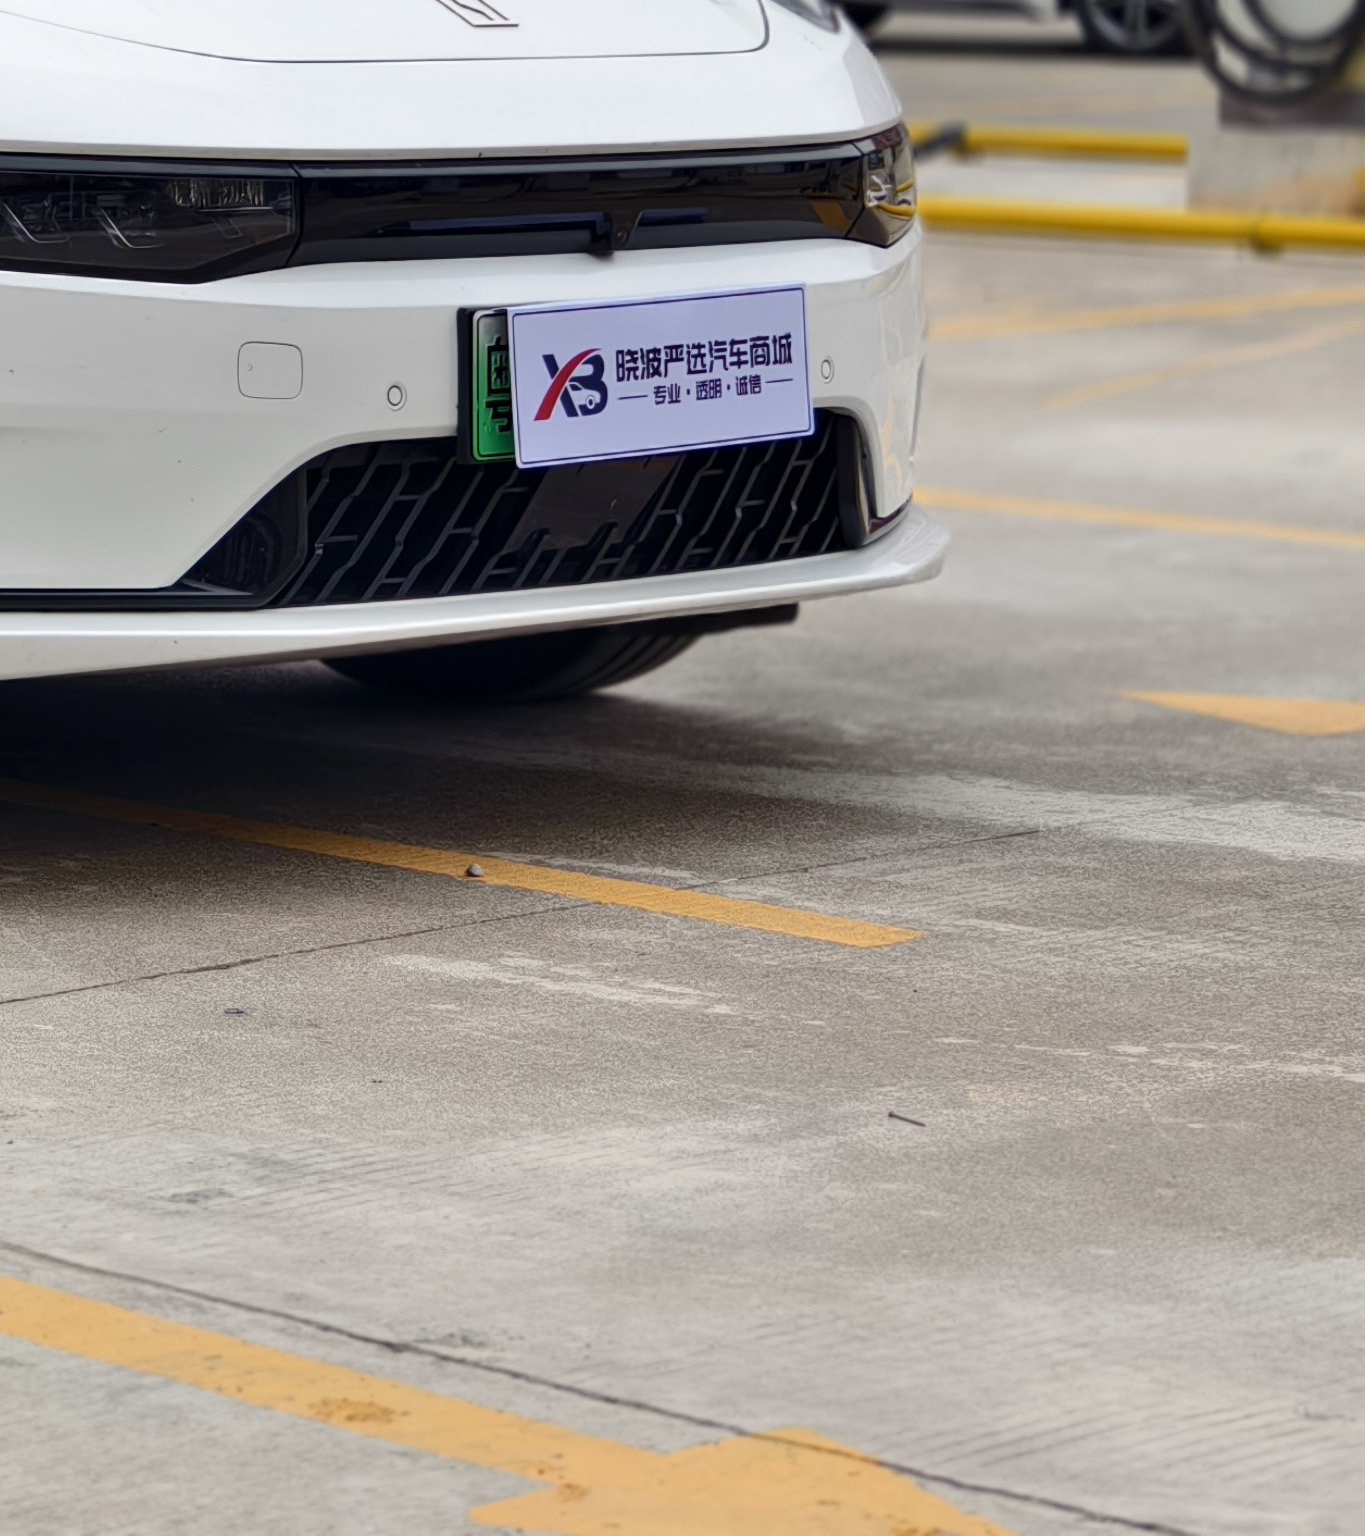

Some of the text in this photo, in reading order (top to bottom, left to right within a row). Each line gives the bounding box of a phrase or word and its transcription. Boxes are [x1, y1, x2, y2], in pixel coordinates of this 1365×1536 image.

[615, 332, 793, 382] 晓波严选汽车商城
